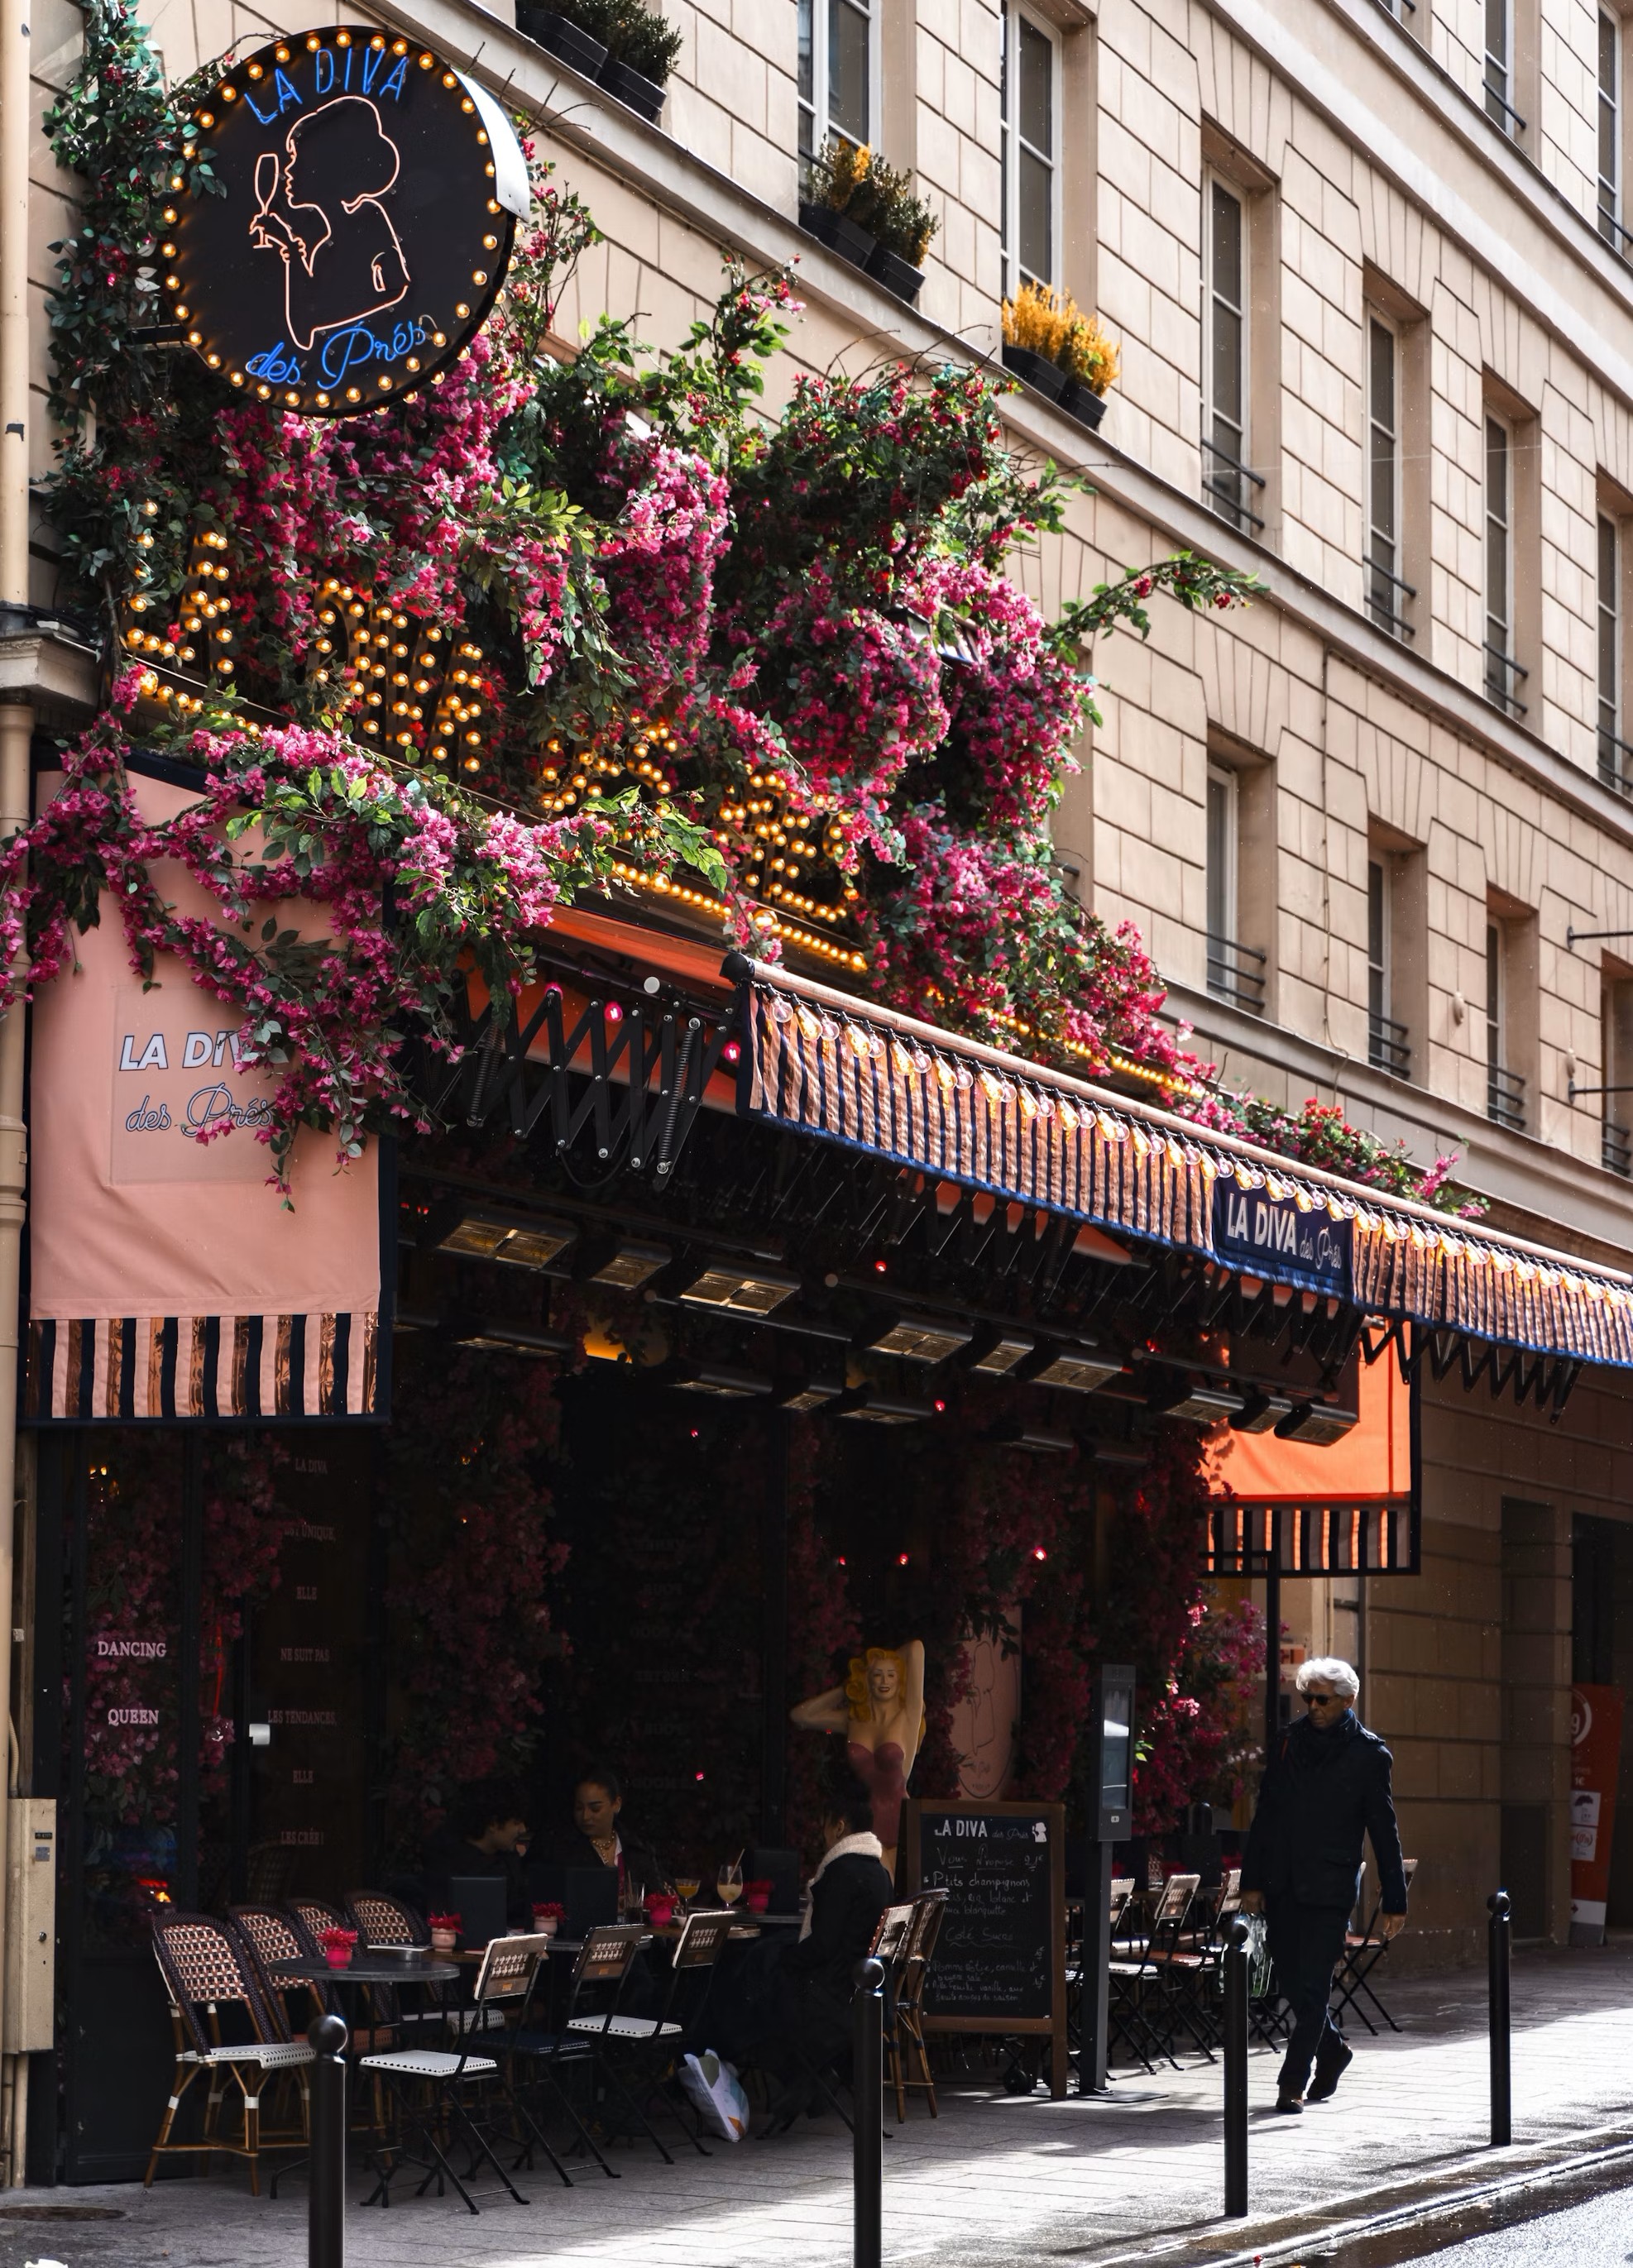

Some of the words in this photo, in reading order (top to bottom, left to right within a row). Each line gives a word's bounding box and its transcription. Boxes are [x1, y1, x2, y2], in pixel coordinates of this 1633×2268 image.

[245, 69, 303, 124] LA
[315, 48, 409, 101] DIVA
[246, 342, 301, 385] des
[317, 319, 426, 390] Prés
[119, 1034, 169, 1071] LA
[182, 1030, 242, 1069] DIV
[126, 1095, 172, 1132] des
[181, 1082, 272, 1137] Prés
[1227, 1193, 1249, 1242] LA
[1254, 1201, 1297, 1256] DIVA
[1300, 1228, 1314, 1261] des
[295, 1457, 306, 1471] LA
[309, 1459, 328, 1474] DIVA
[296, 1586, 318, 1601] ELLE
[98, 1641, 167, 1659] DANCING
[280, 1648, 293, 1661] NE
[294, 1648, 314, 1662] SUIT
[315, 1648, 331, 1663] PAS
[108, 1709, 159, 1726] QUEEN
[267, 1710, 283, 1723] LES
[293, 1770, 314, 1783] ELLE
[280, 1830, 296, 1845] LES
[955, 1821, 988, 1837] DIVA
[969, 1872, 1031, 1892] champignons
